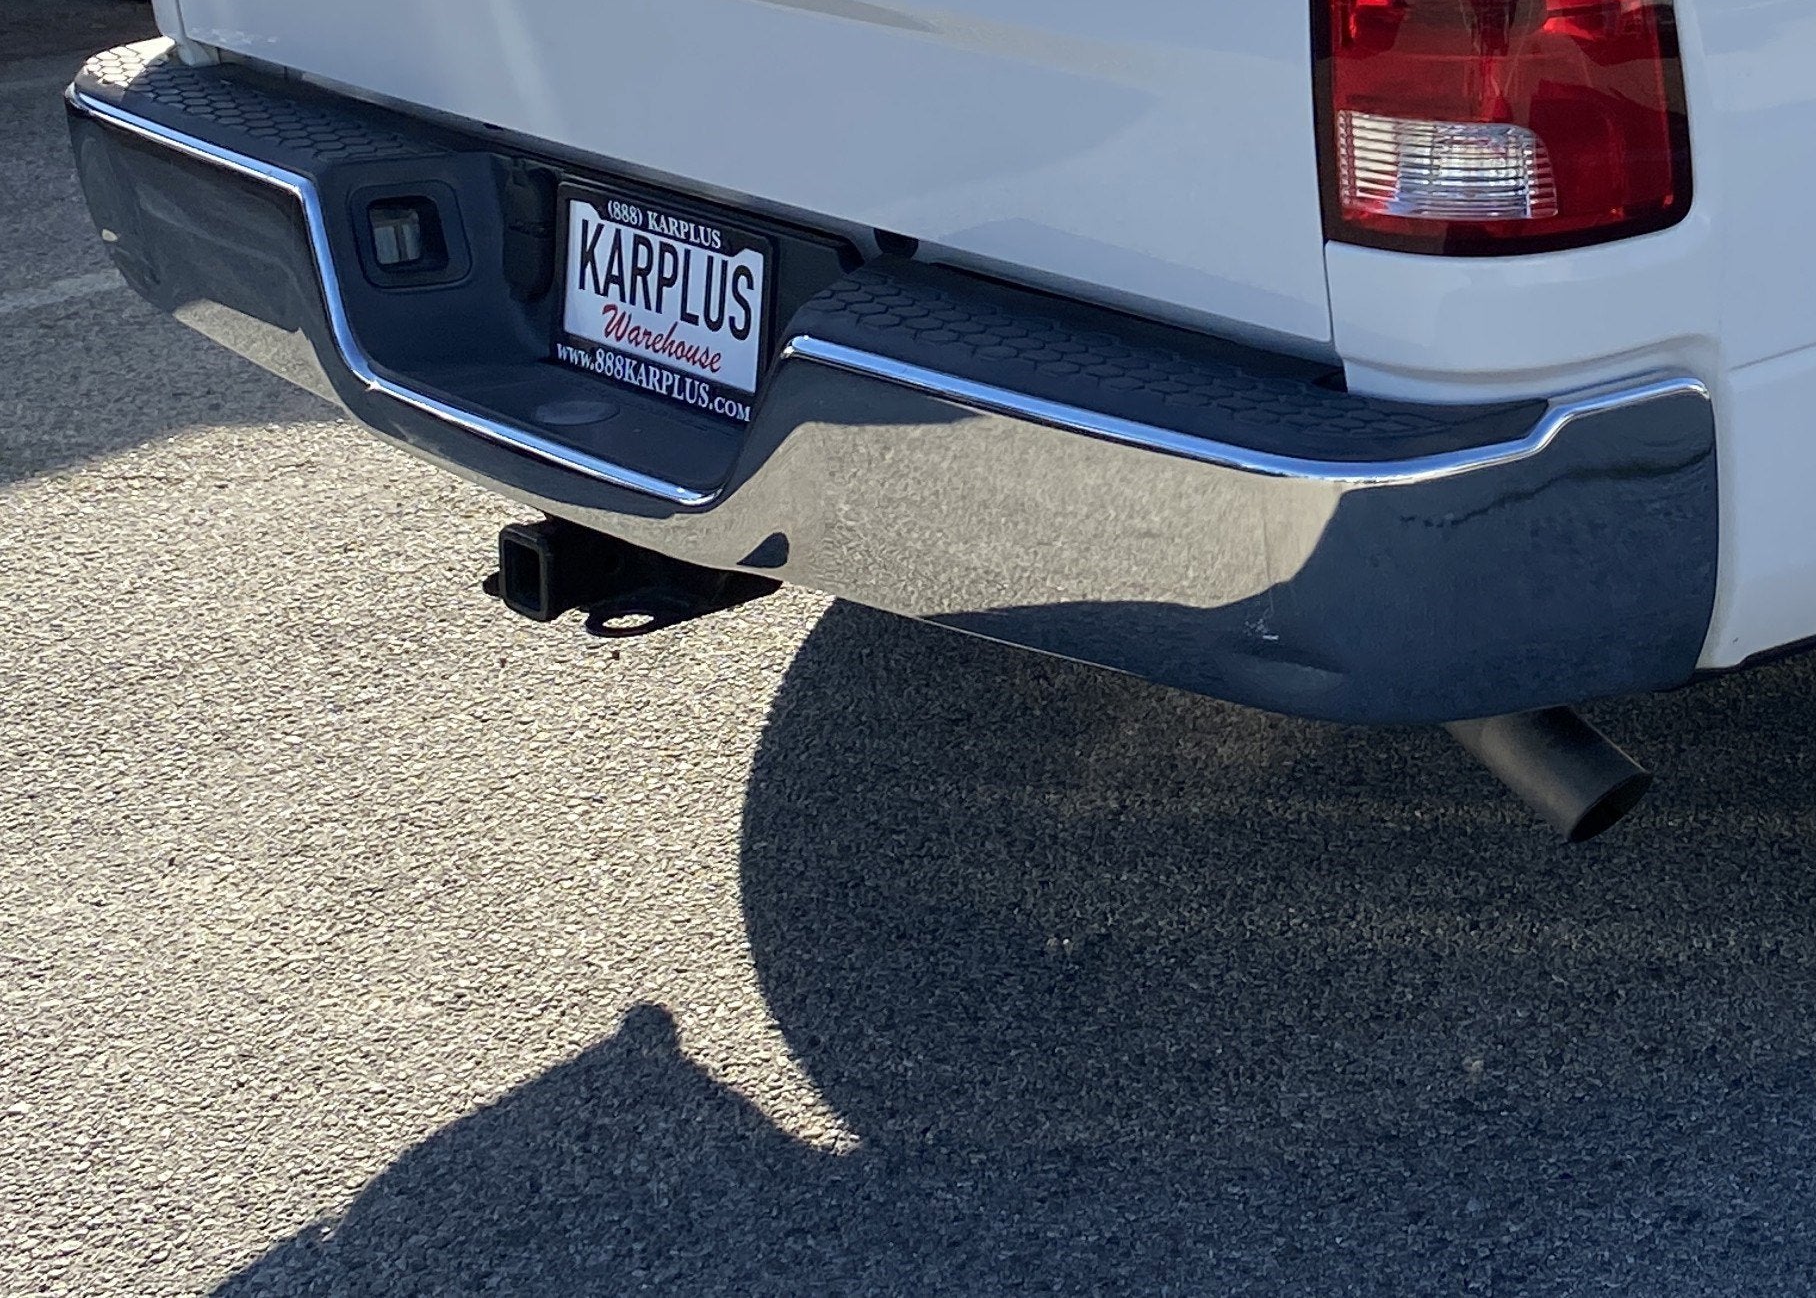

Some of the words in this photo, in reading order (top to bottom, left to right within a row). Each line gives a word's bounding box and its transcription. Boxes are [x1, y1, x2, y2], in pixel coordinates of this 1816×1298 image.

[608, 200, 642, 226] (888)
[646, 210, 721, 249] KARPLUS
[578, 218, 755, 341] KARPLUS
[602, 303, 721, 373] Warehouse
